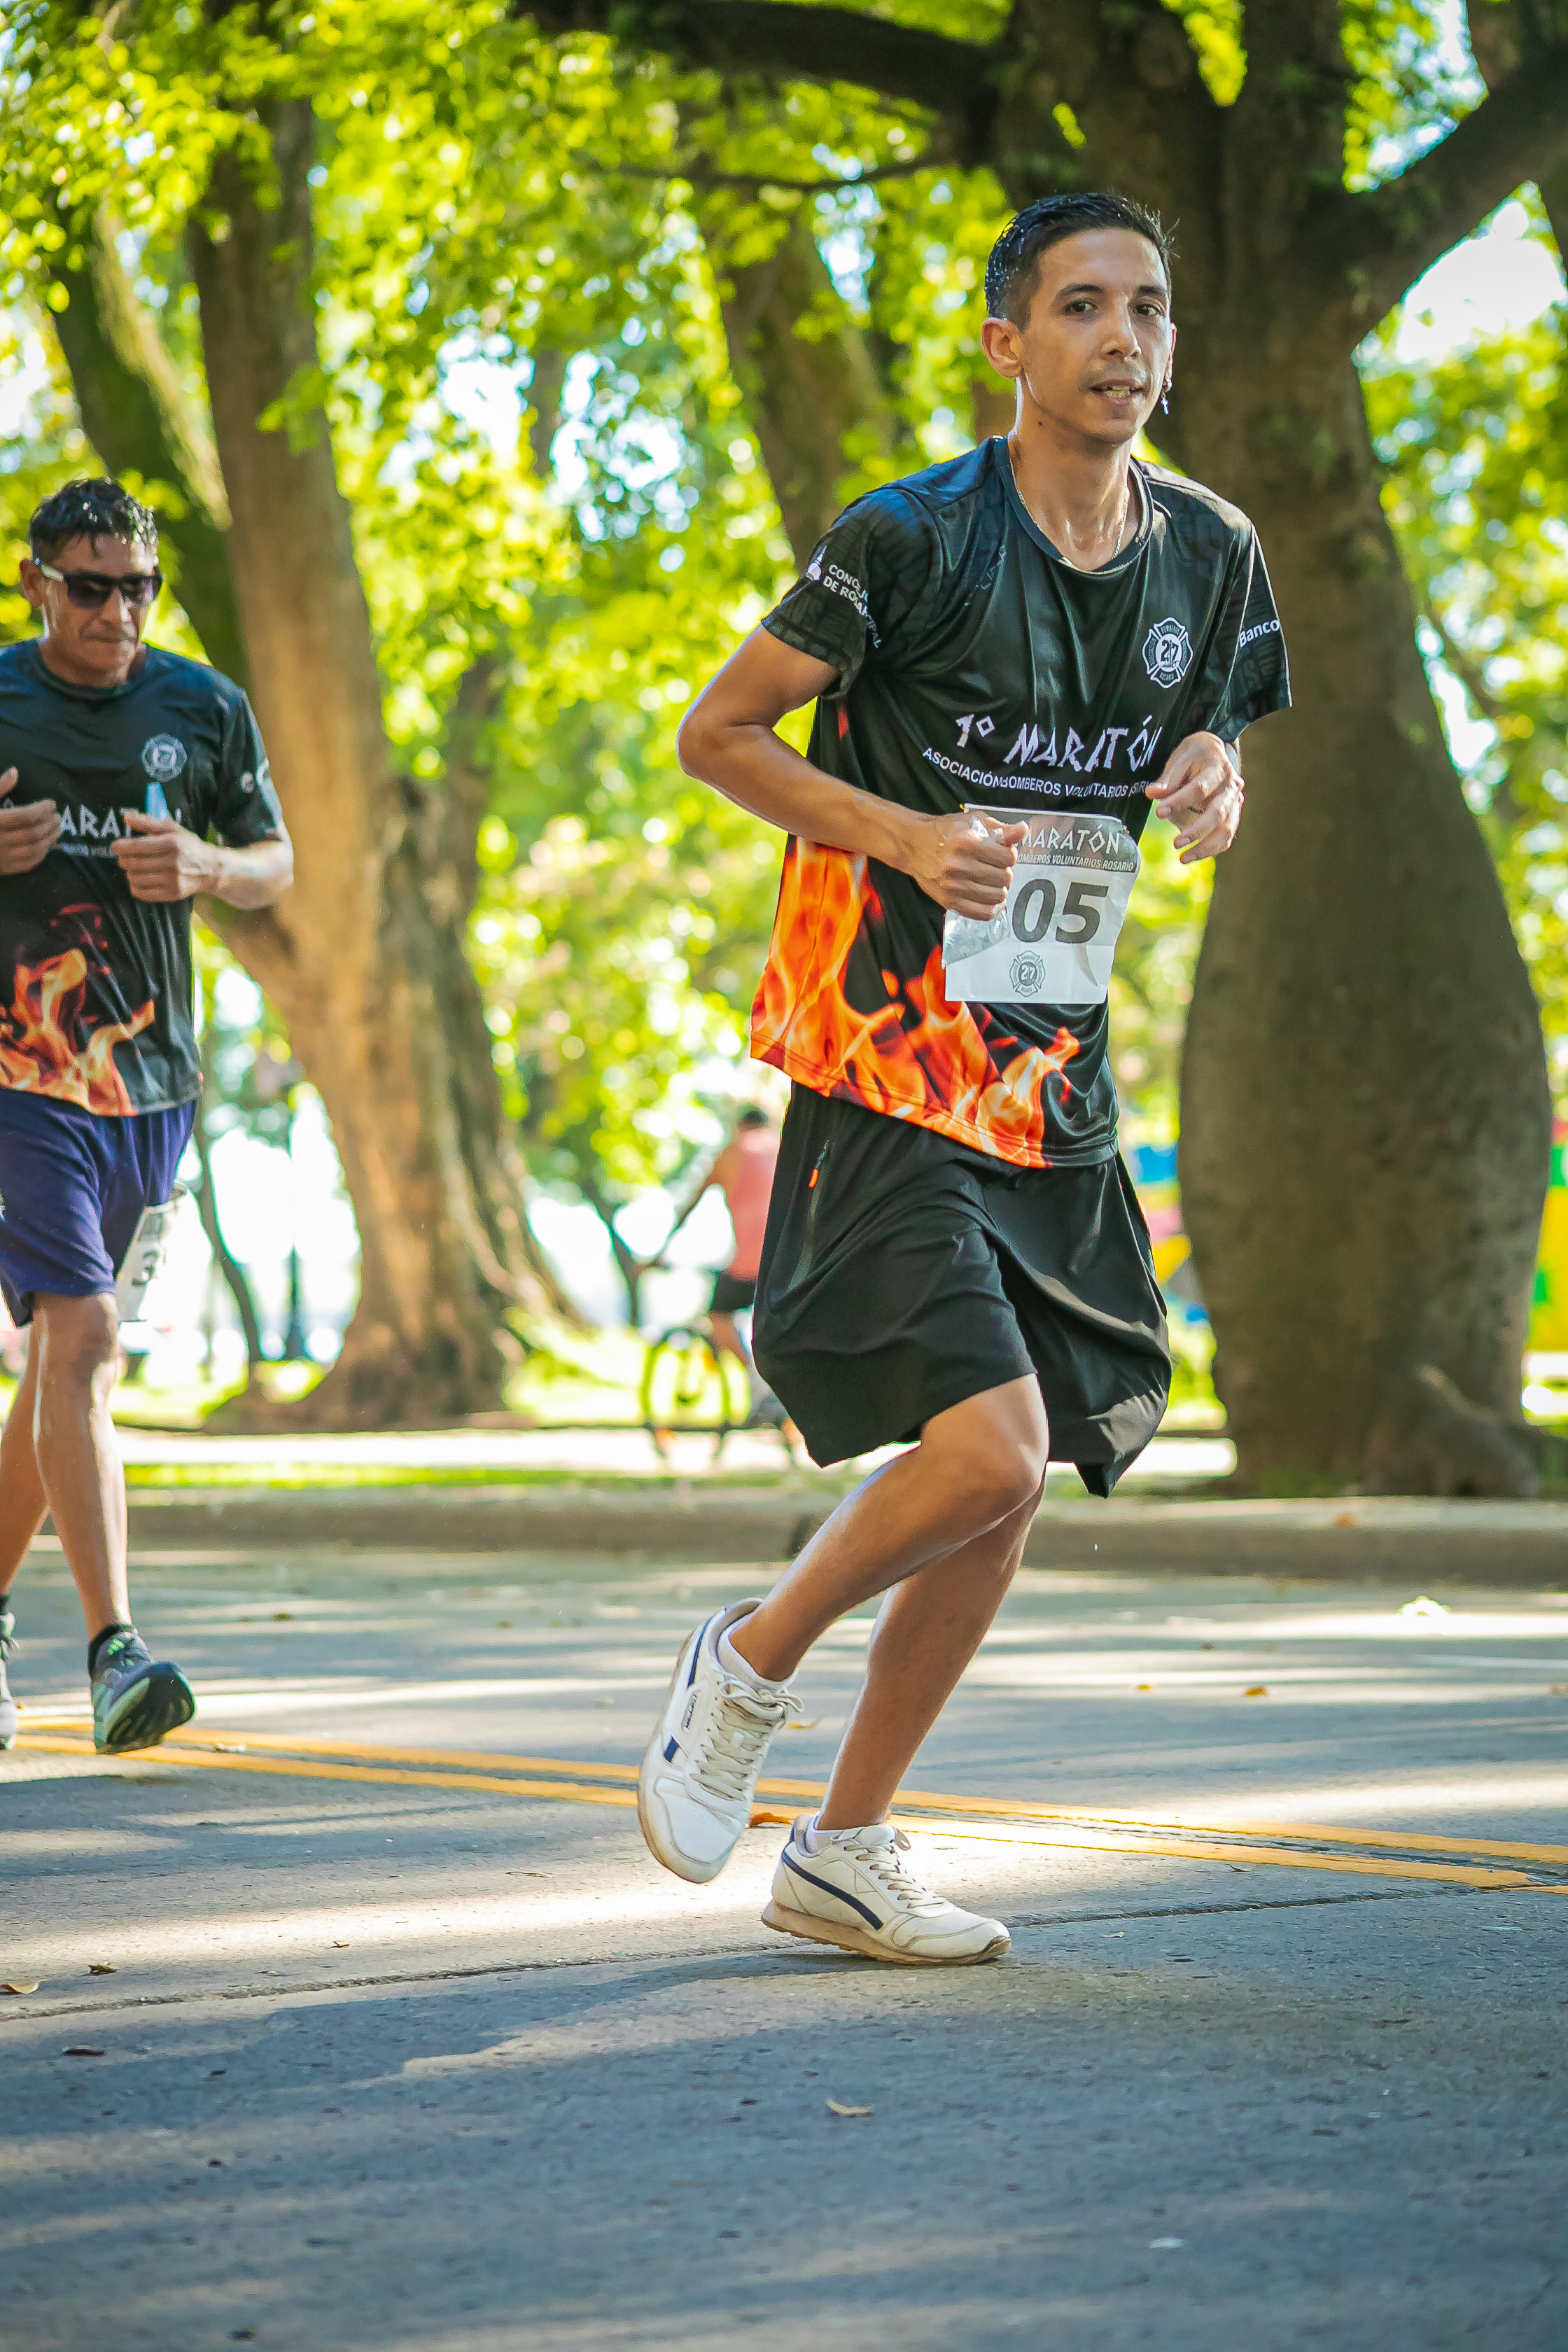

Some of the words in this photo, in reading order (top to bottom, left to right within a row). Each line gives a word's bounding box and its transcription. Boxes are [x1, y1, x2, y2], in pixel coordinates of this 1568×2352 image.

[823, 575, 839, 592] DE
[1238, 619, 1280, 648] Banco
[1161, 639, 1180, 662] 27
[1018, 854, 1051, 864] OMBEROS
[1052, 855, 1102, 869] VOLUNTARIOS
[1102, 860, 1134, 872] ROSARIO
[1021, 964, 1036, 981] 27
